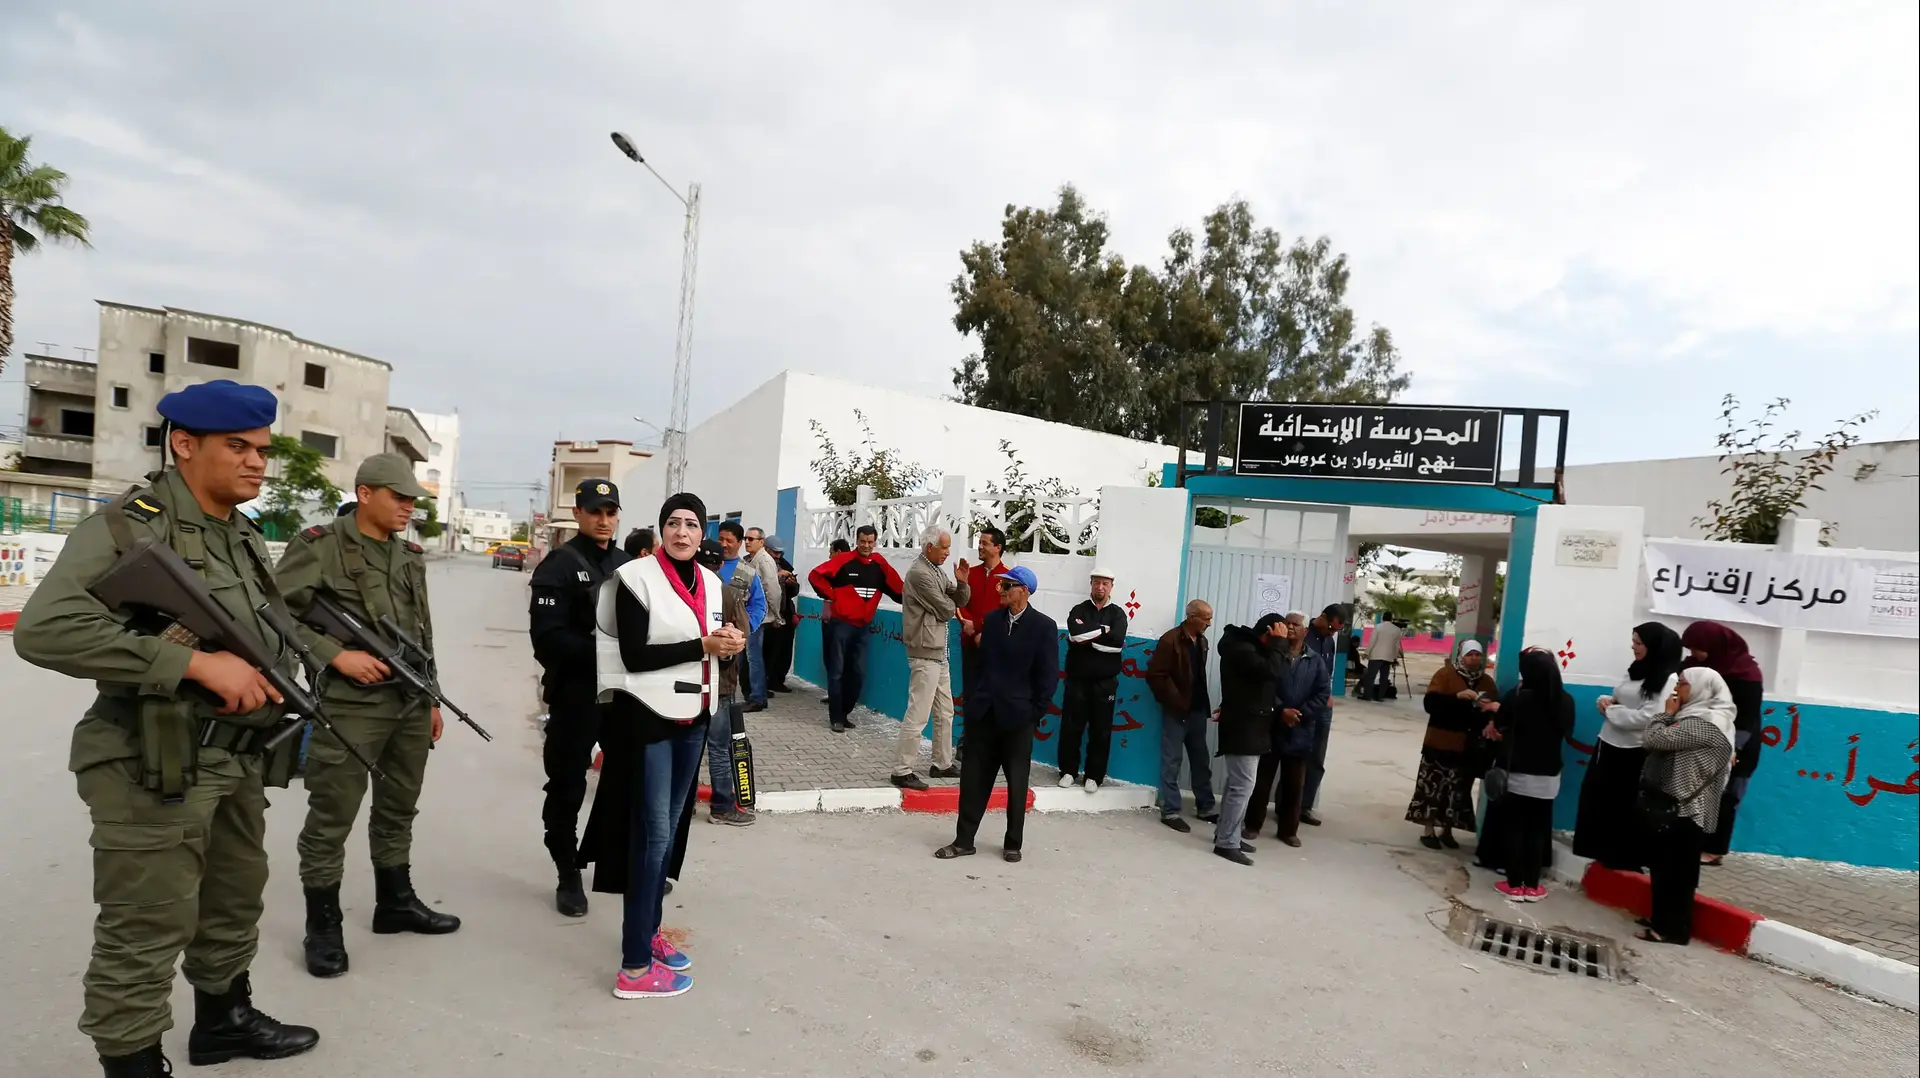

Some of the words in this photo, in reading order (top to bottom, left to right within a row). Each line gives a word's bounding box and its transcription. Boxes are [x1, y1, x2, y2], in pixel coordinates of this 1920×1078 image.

[1369, 415, 1481, 446] المدرسة
[1279, 452, 1327, 467] عروس
[1329, 453, 1348, 469] بن
[1351, 450, 1414, 472] القيروان
[1417, 455, 1456, 475] نهج
[1651, 564, 1753, 604] إقتراع
[1756, 577, 1847, 610] مركز
[538, 597, 556, 606] BIS
[738, 761, 751, 801] GARRETT
